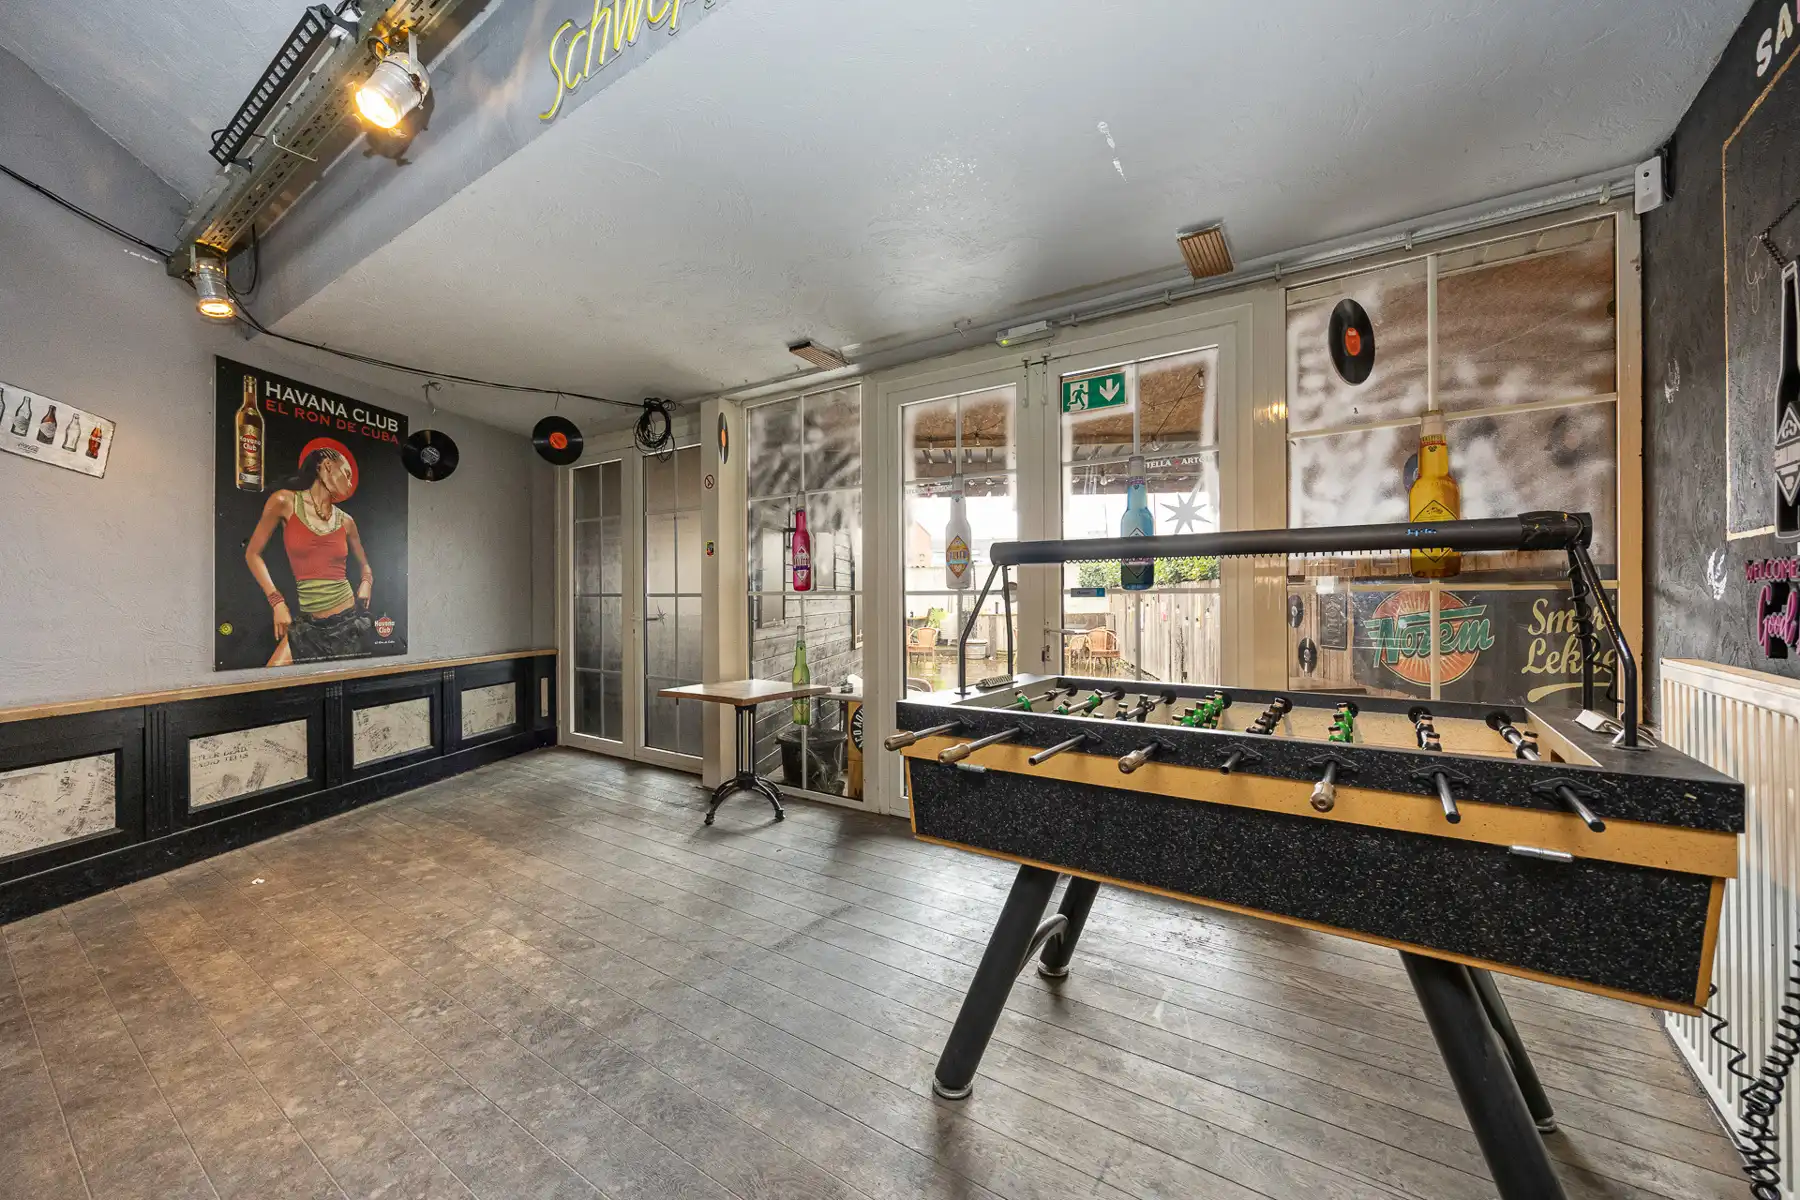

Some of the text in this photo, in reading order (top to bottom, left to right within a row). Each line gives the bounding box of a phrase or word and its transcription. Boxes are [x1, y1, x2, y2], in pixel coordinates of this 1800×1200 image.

[539, 0, 680, 119] Schw
[1756, 2, 1800, 77] SA
[265, 380, 399, 433] HAVANA CLUB
[265, 399, 399, 444] EL RON DE CUBA
[1144, 455, 1214, 469] TELLA ARTO
[1744, 558, 1797, 583] WELCOME
